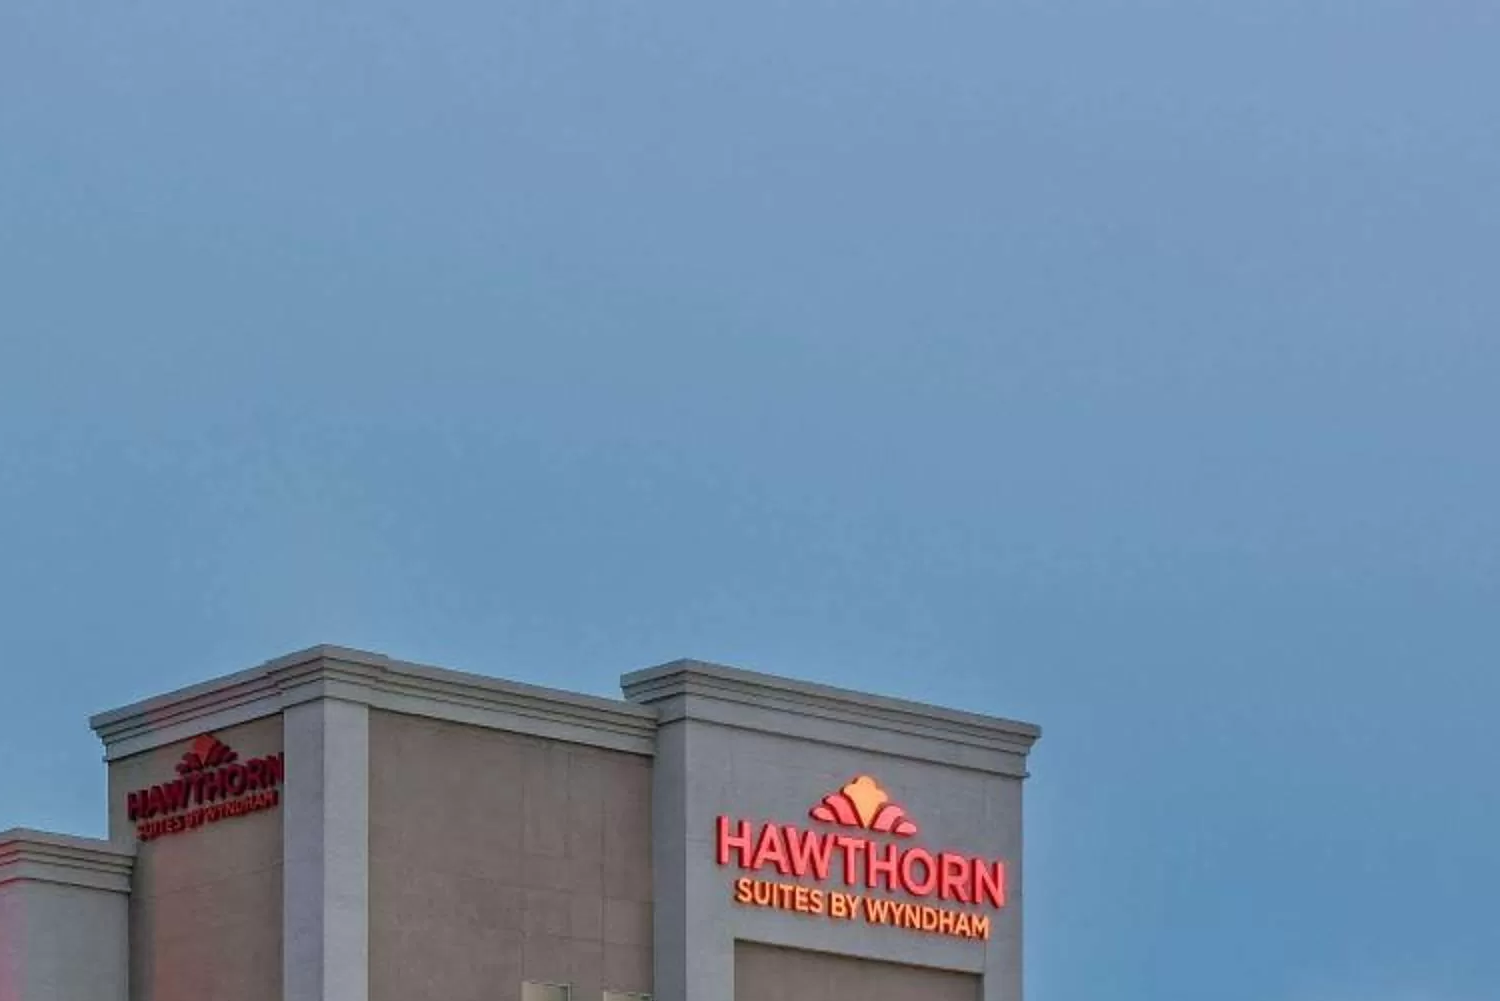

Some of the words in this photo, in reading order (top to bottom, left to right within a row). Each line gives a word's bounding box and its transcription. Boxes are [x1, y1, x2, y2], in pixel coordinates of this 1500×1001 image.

[127, 752, 284, 821] HAWTHORN
[136, 816, 183, 841] SUITES
[716, 815, 1005, 908] HAWTHORN
[734, 878, 823, 914] SUITES
[828, 891, 859, 921] BY
[863, 897, 990, 940] WYNDHAM
